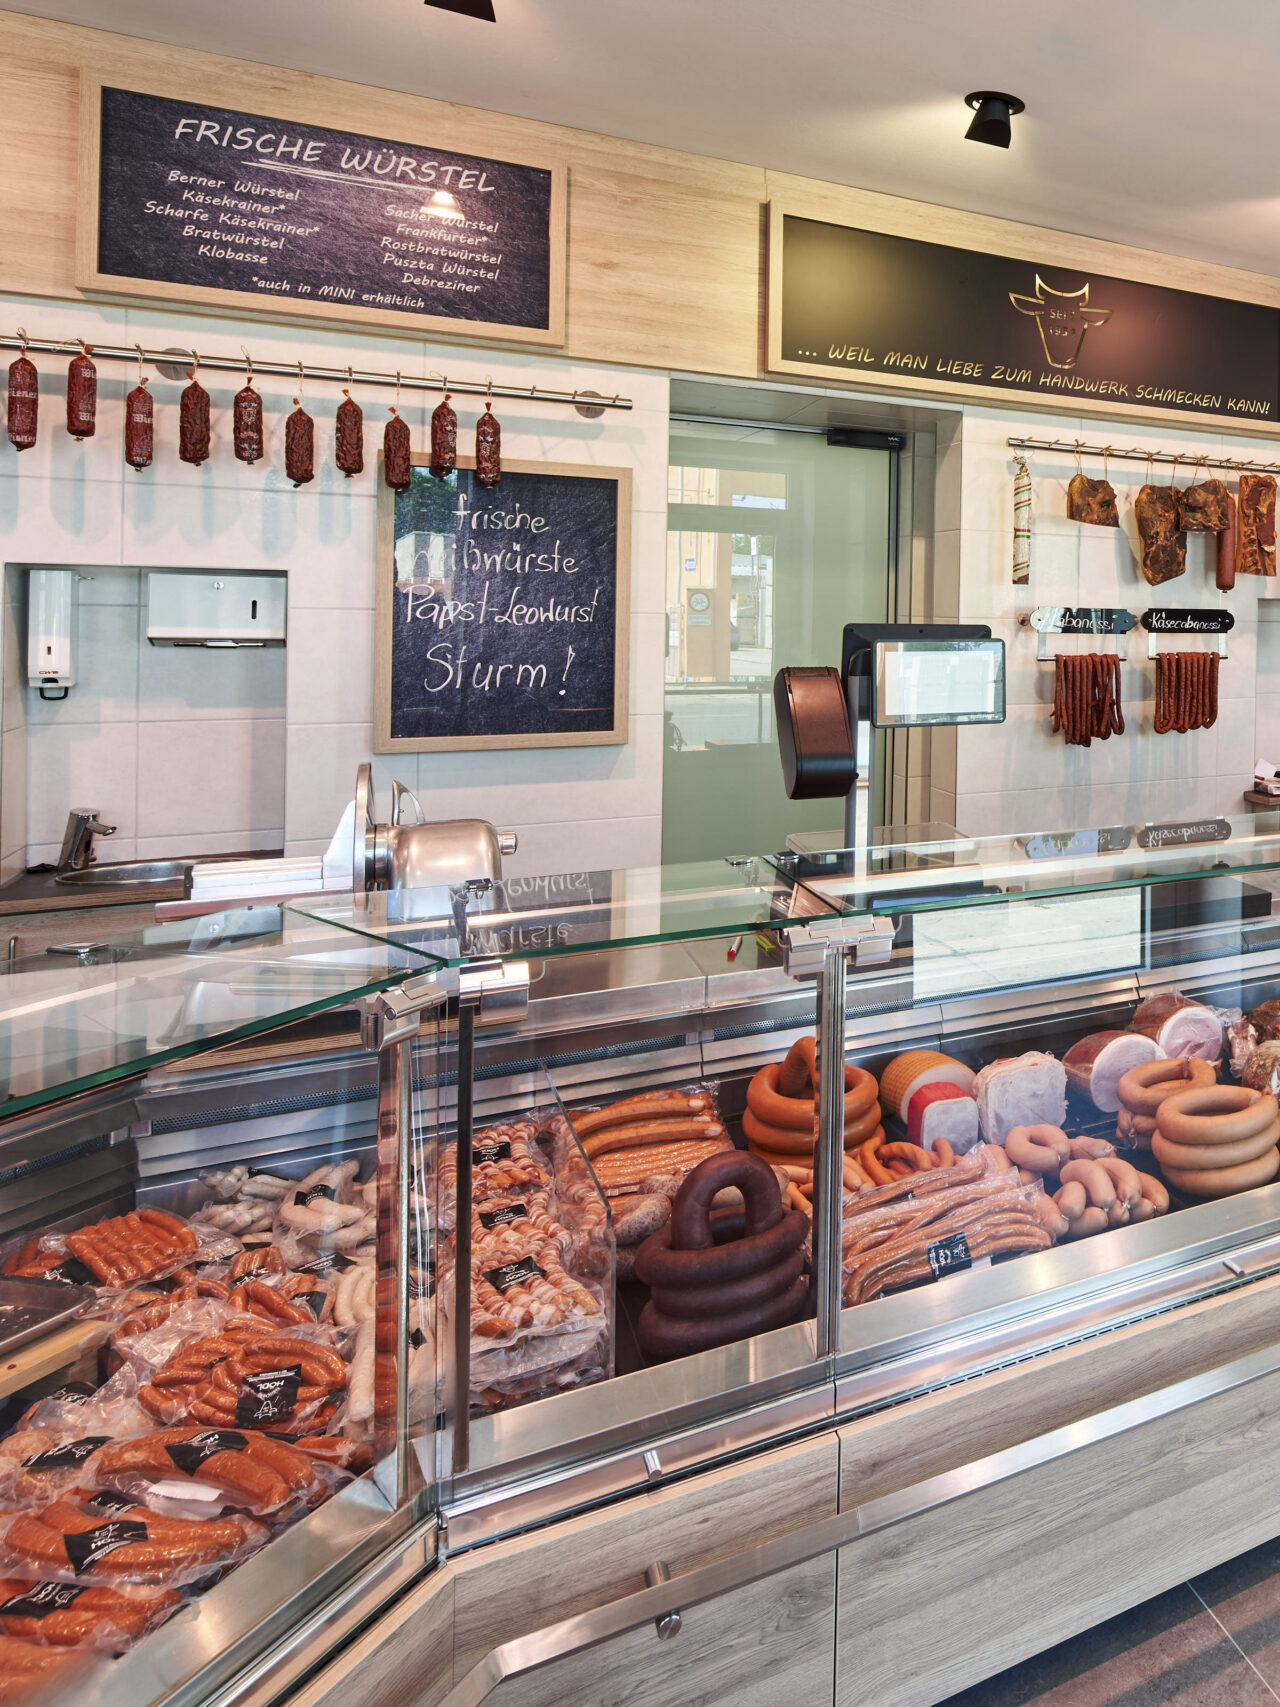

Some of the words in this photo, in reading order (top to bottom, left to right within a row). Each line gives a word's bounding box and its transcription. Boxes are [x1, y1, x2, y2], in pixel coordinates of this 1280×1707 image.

[175, 119, 327, 162] FRISCHE
[341, 147, 496, 193] WÜRSTEL
[167, 170, 225, 192] Berner
[233, 179, 301, 201] Würstel
[144, 201, 210, 222] Scharfe
[384, 204, 435, 222] Sacher
[182, 226, 285, 250] Bratwürstel
[380, 236, 502, 265] Rostbratwürstel
[198, 244, 269, 266] Klobasse
[382, 252, 435, 271] Puszta
[442, 262, 500, 281] Würstel
[298, 282, 311, 295] in
[318, 285, 355, 302] MINI
[362, 289, 425, 309] erhältlich
[401, 272, 481, 293] Debreziner
[828, 344, 875, 363] WEIL
[882, 351, 930, 371] MAN
[936, 357, 983, 377] LIEBE
[991, 365, 1032, 384] ZUM
[1038, 371, 1129, 397] HANDWERK
[1134, 385, 1222, 410] SCHMECKEN
[1227, 398, 1271, 415] KANN!
[424, 643, 547, 692] Sturm
